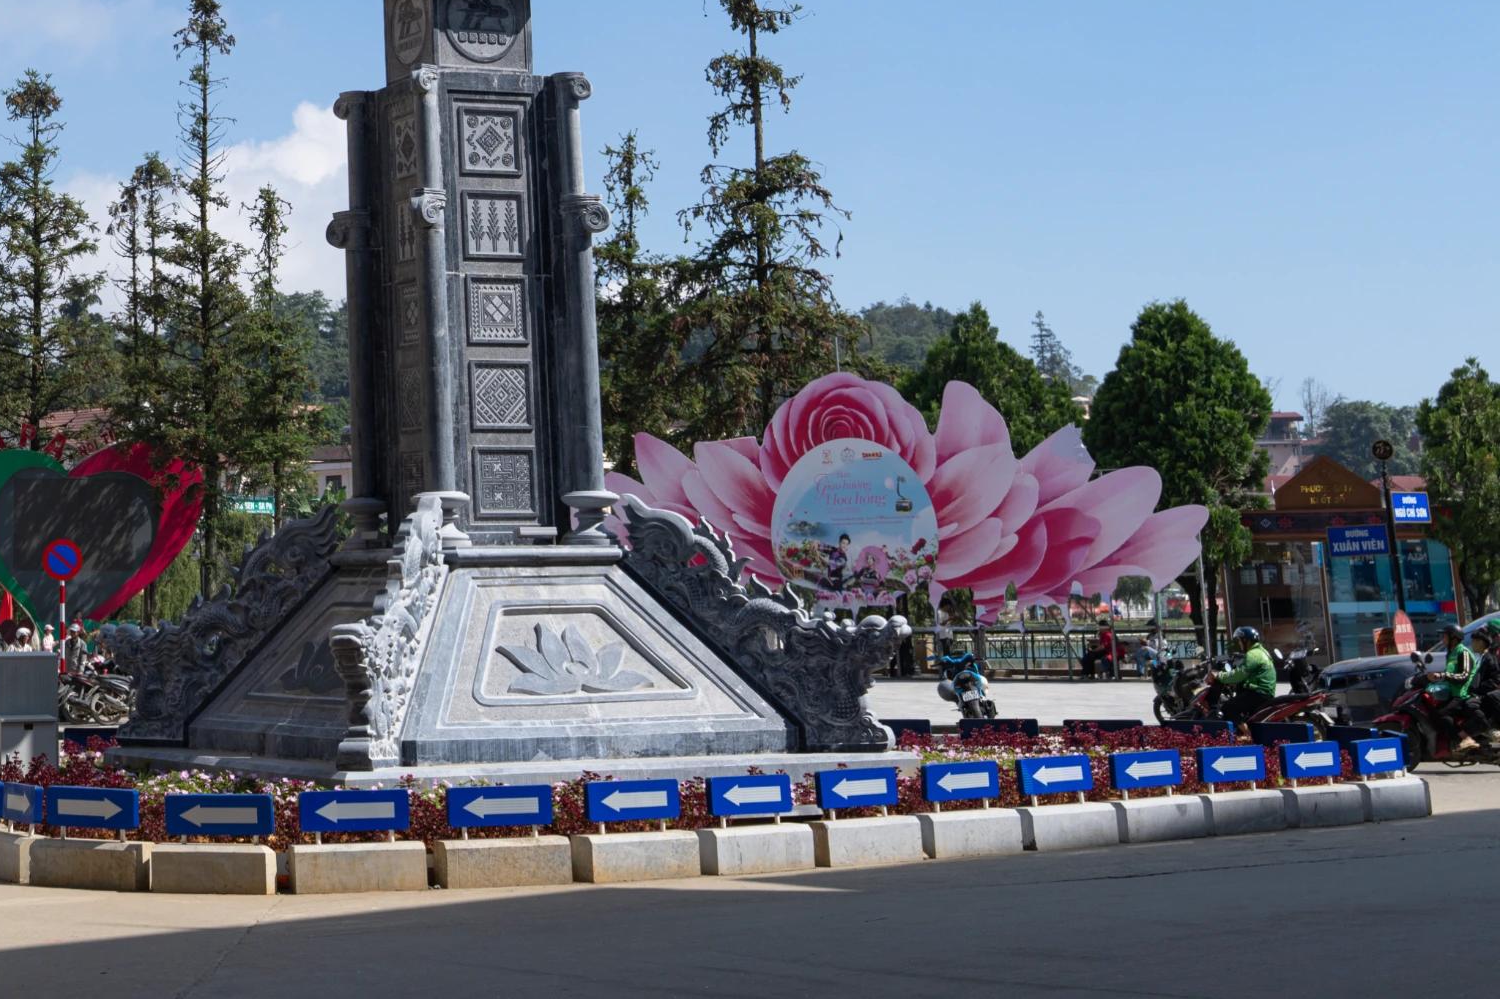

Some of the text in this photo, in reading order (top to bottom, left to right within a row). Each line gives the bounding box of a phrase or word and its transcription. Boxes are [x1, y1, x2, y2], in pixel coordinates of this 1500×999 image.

[1345, 529, 1369, 538] ĐƯỜNG
[1332, 538, 1385, 552] XUÂN VIÊN
